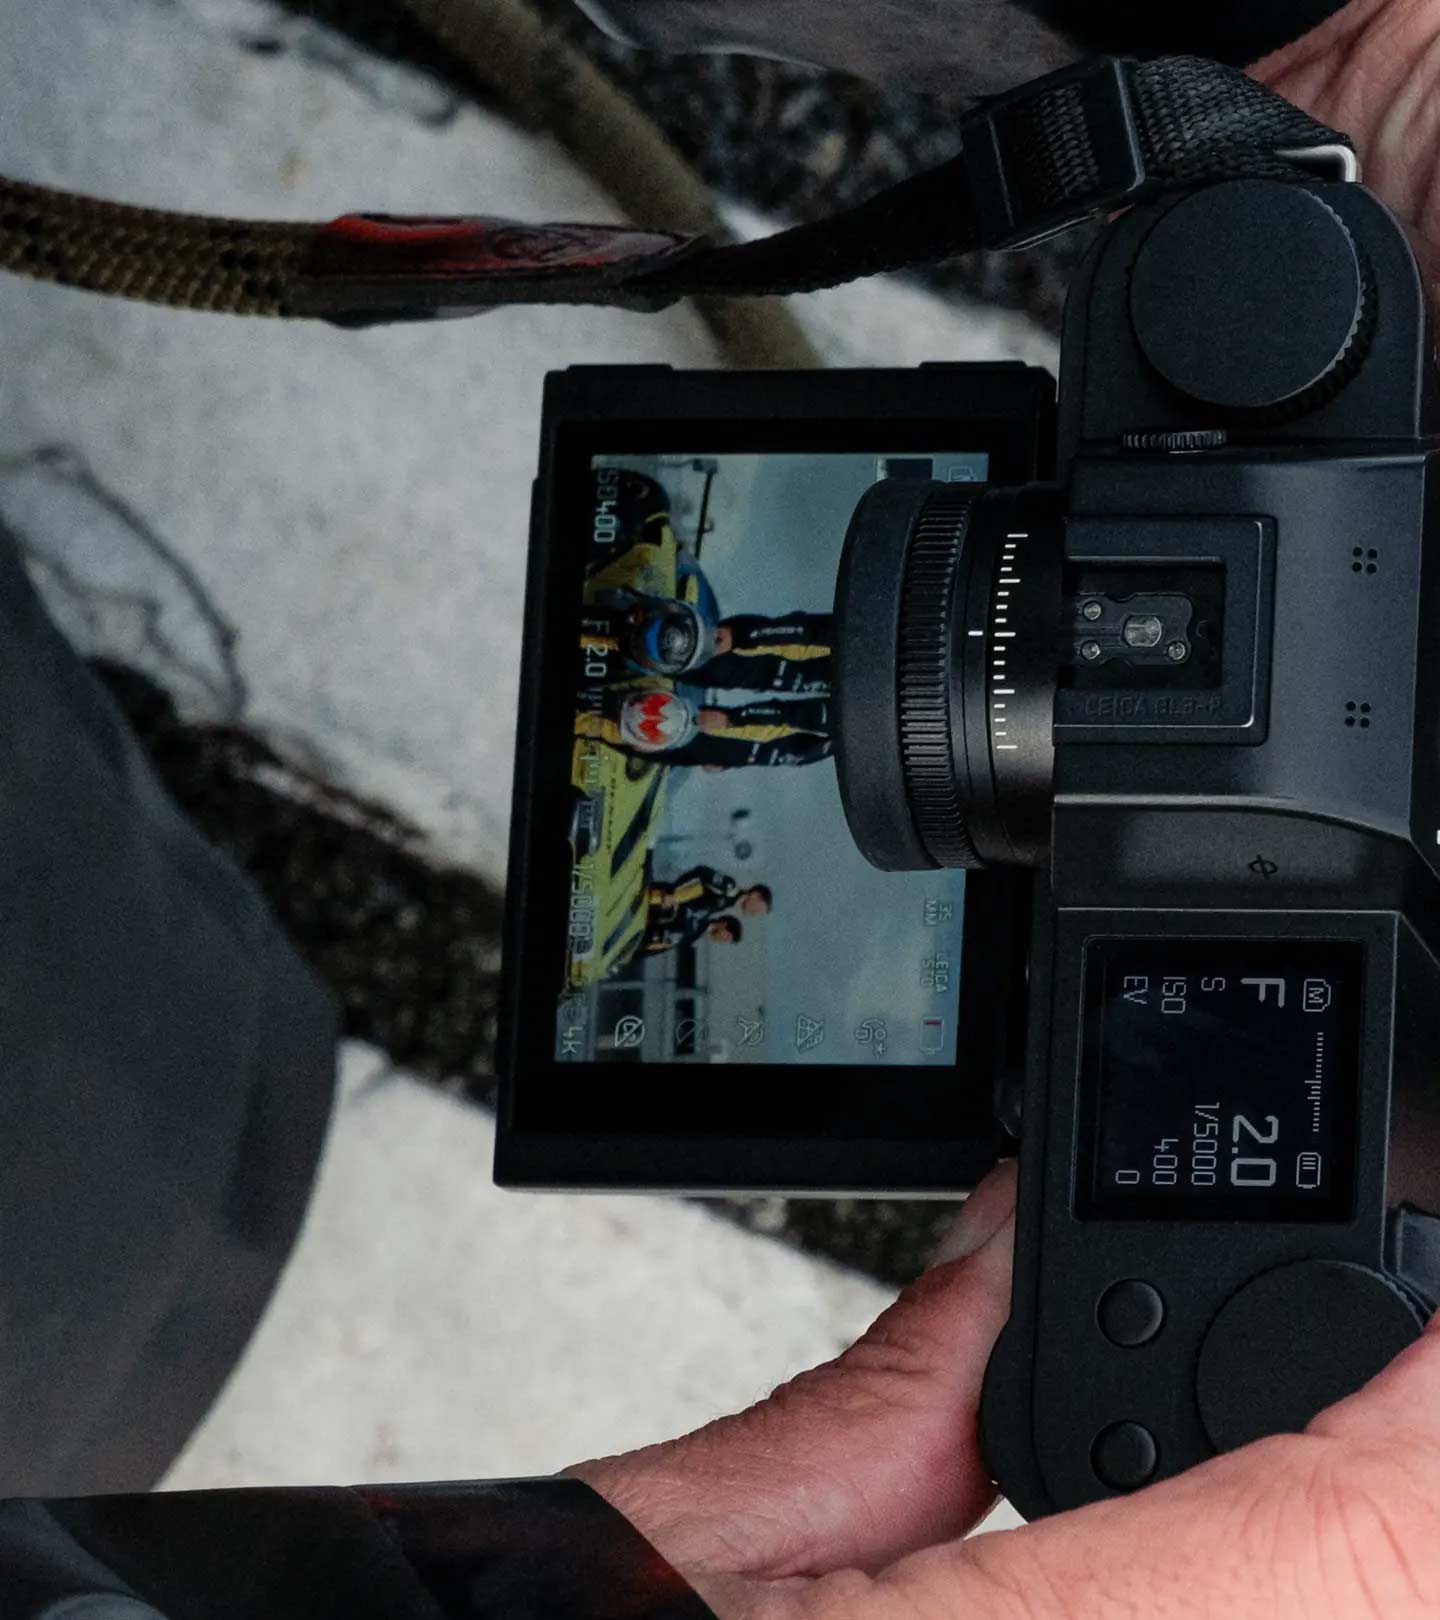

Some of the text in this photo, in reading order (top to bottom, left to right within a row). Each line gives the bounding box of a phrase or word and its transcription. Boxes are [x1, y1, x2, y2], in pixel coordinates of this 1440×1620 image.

[584, 644, 609, 678] 2.0
[934, 953, 949, 993] LEICA
[1115, 975, 1149, 1184] EV 0
[1152, 976, 1187, 1185] ISO 400
[1191, 976, 1226, 1186] S 1/5000
[1230, 977, 1286, 1187] F 2.0
